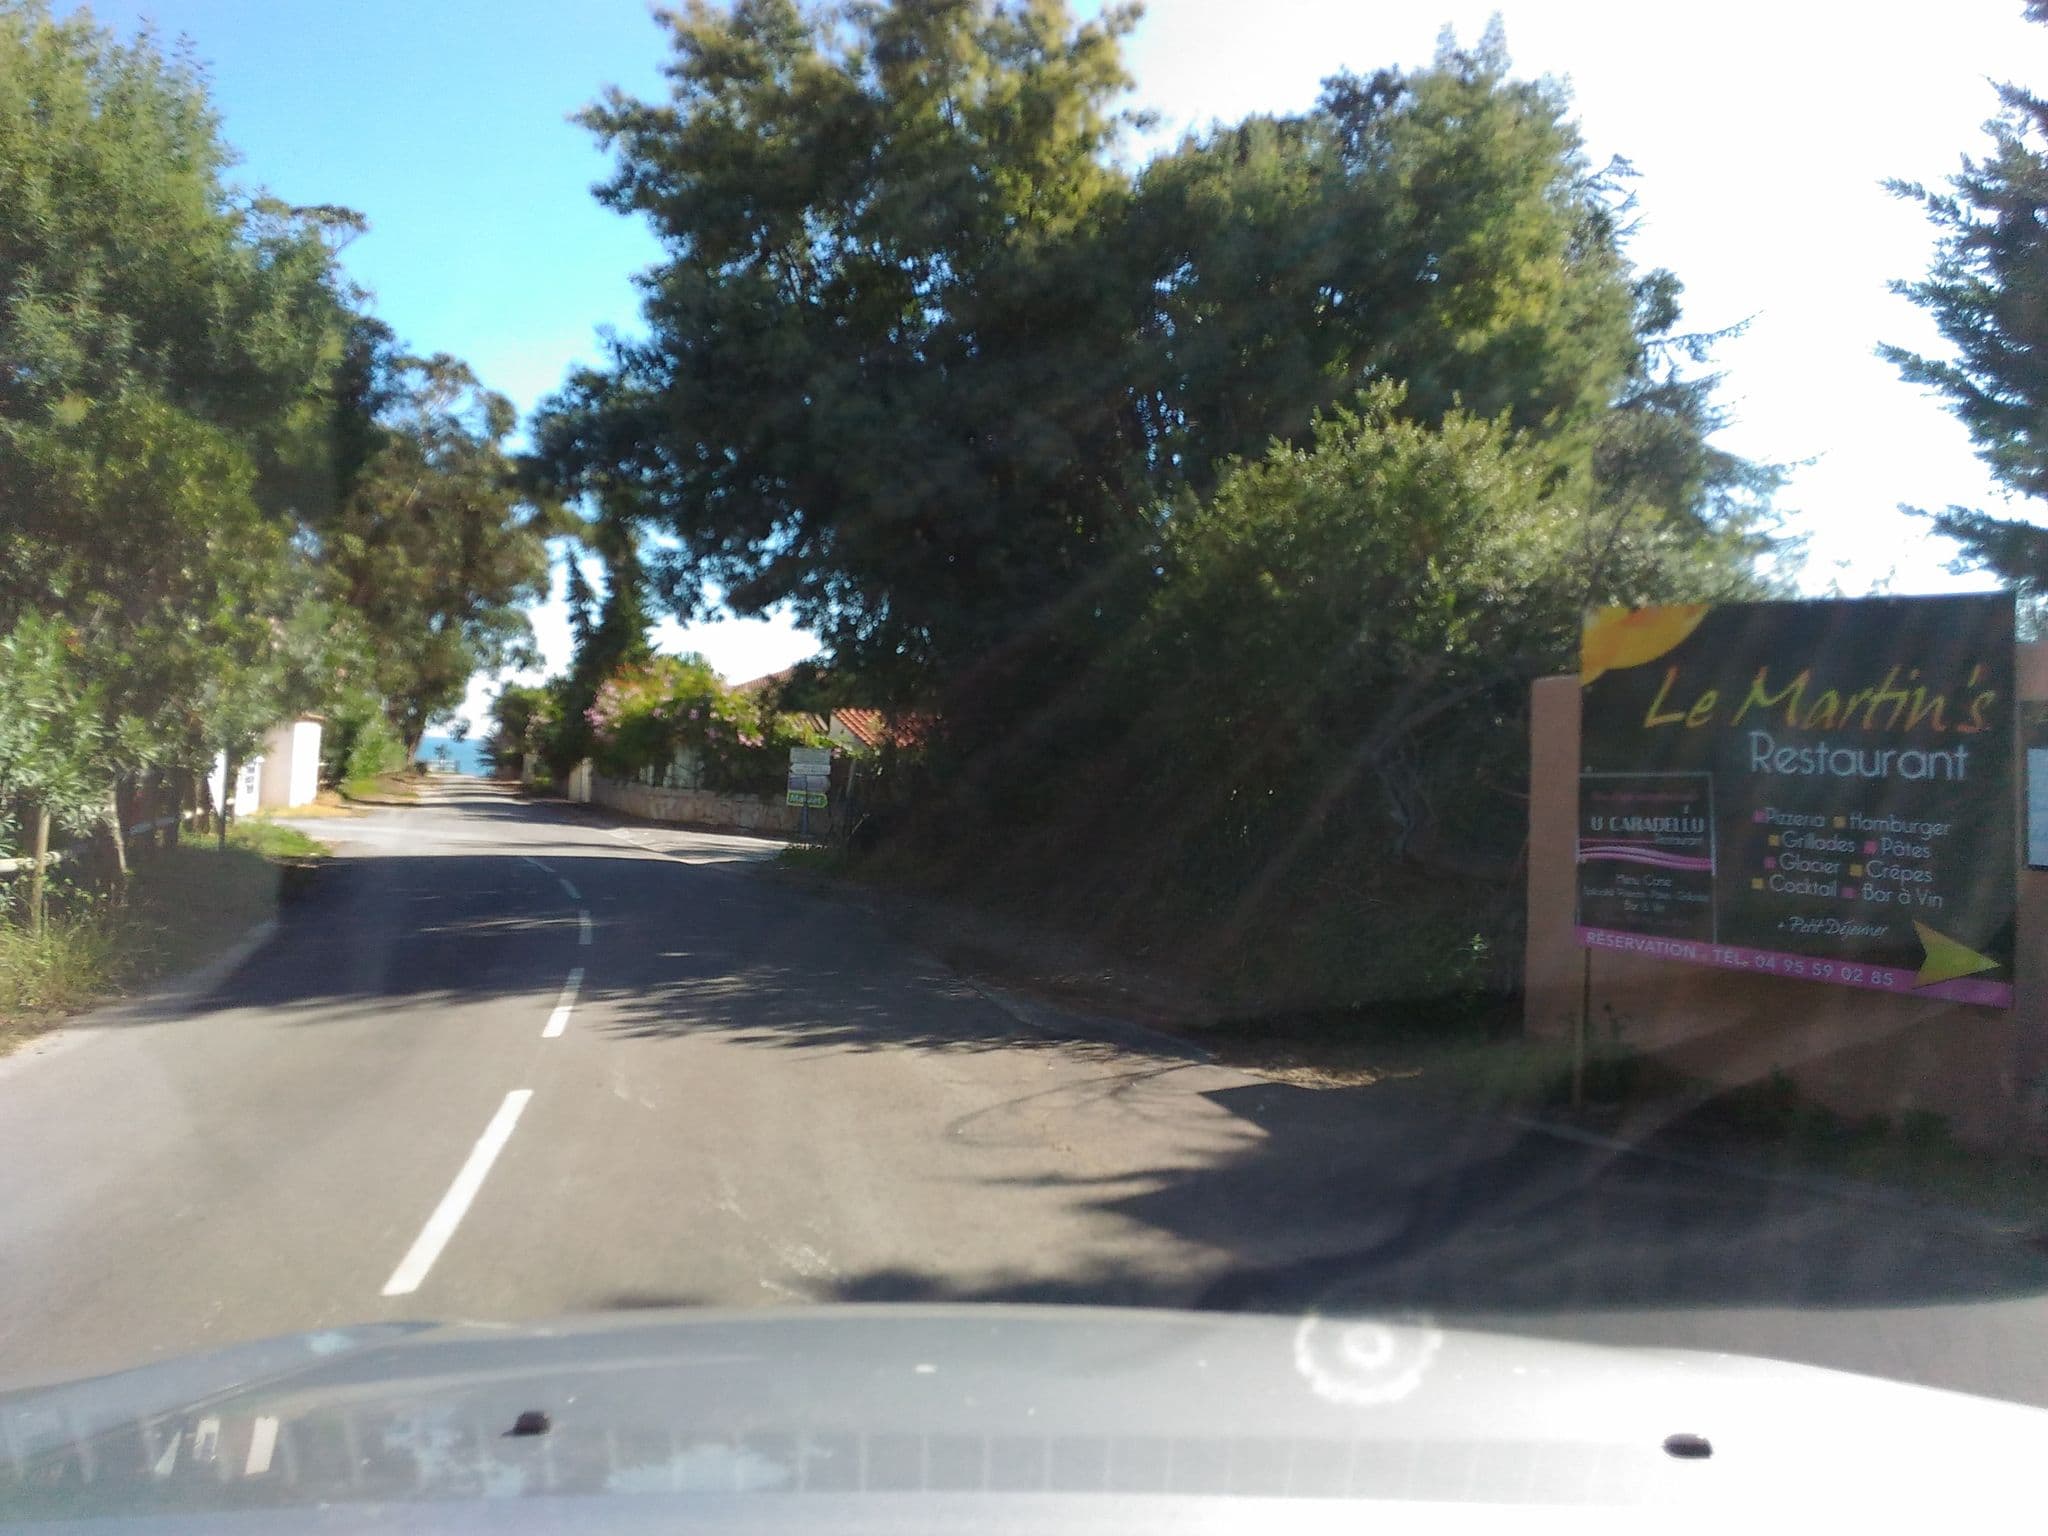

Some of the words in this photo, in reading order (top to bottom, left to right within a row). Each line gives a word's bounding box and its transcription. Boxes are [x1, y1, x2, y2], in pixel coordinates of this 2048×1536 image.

[1643, 665, 1719, 728] Le
[1731, 664, 1996, 732] Martin's
[1750, 731, 1968, 780] Restaurant
[1765, 807, 1826, 828] Pizzeria
[1850, 811, 1953, 840] Hamburger
[1782, 830, 1856, 852] Grillades
[1880, 835, 1931, 858] Pâtes
[1779, 852, 1840, 873] Glacier
[1866, 859, 1934, 885] Crêpes
[1769, 874, 1839, 896] Cocktail
[1862, 881, 1893, 903] Bar
[1898, 887, 1911, 904] à
[1918, 887, 1944, 909] Vin
[1789, 915, 1824, 934] Petit
[1755, 955, 1776, 969] 04
[1784, 959, 1805, 974] 95
[1812, 962, 1833, 977] 59
[1841, 965, 1864, 983] 02
